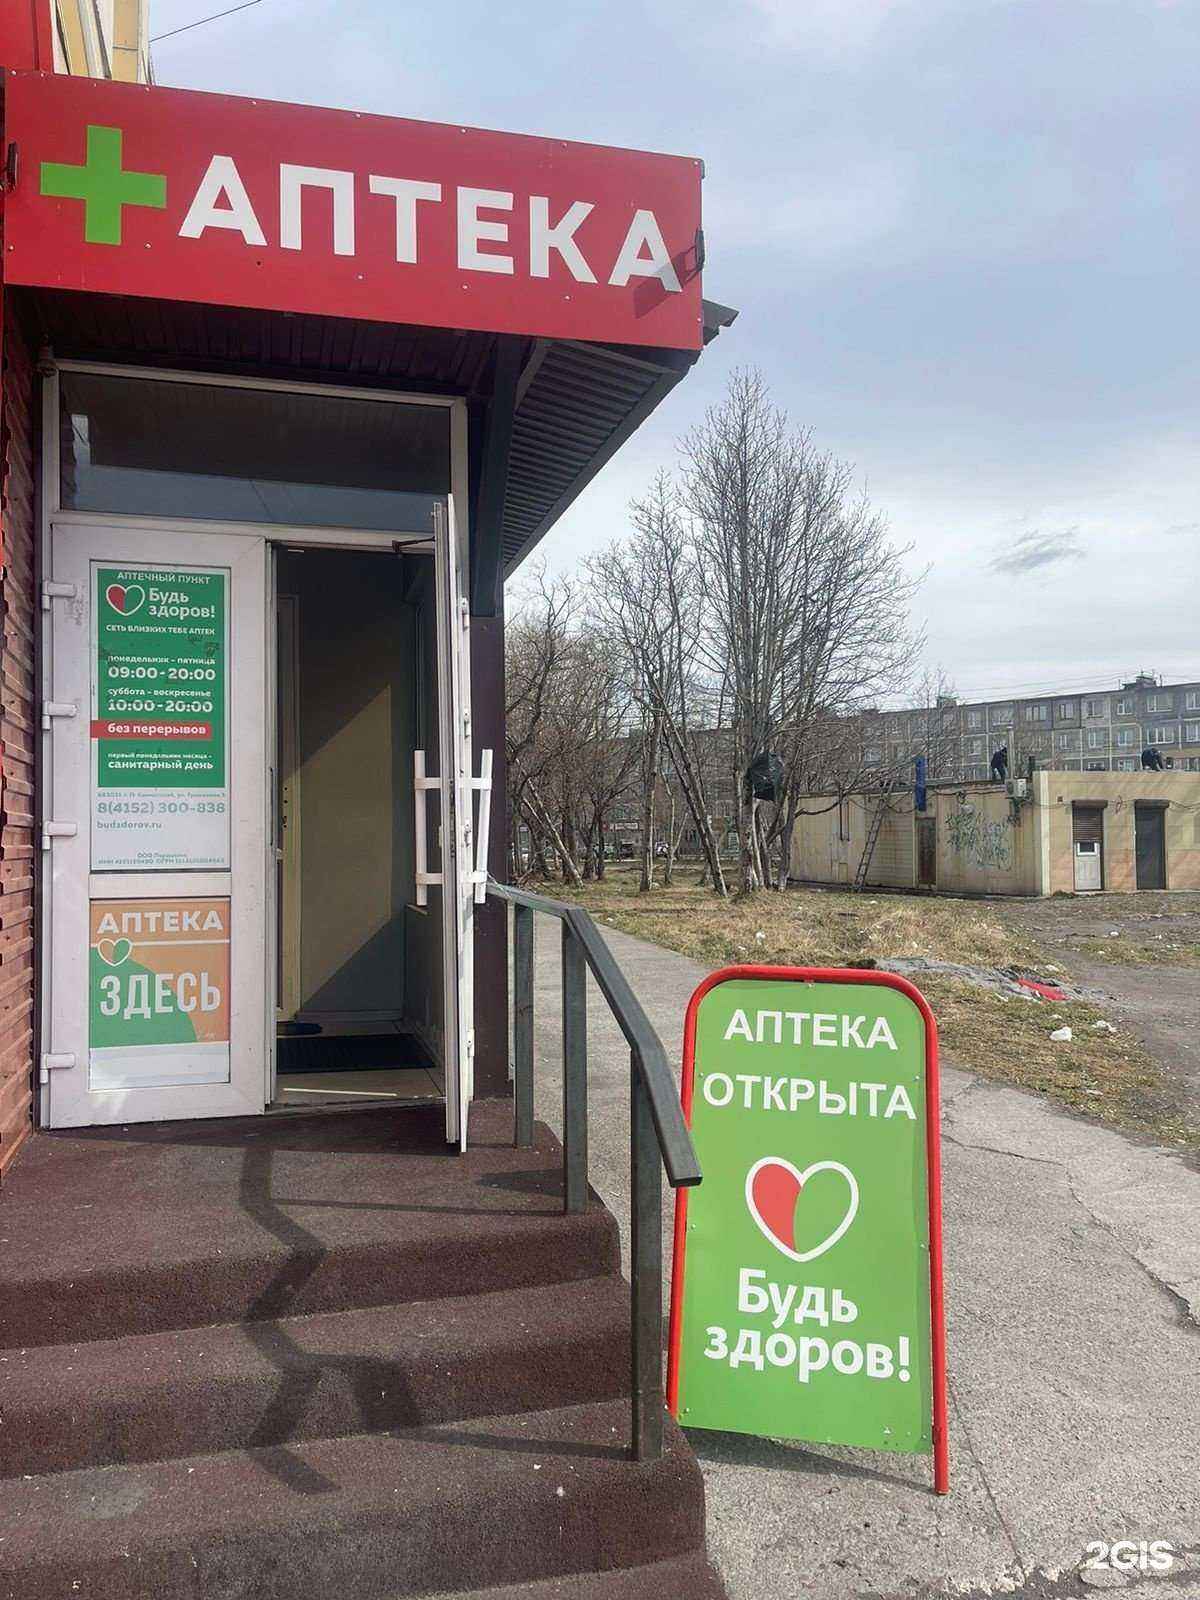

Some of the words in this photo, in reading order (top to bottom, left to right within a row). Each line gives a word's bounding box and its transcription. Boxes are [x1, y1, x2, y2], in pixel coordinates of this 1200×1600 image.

[178, 155, 682, 292] АПТЕКА
[117, 572, 176, 583] АПТЕЧНЫЙ
[178, 575, 211, 585] ПУНКТ
[148, 587, 189, 605] Будь
[148, 605, 215, 620] здоров!
[106, 624, 127, 632] СЕТЬ
[107, 655, 169, 664] понедельник
[177, 657, 216, 665] пятница
[108, 687, 145, 697] суббота
[153, 689, 211, 698] воскресенье
[107, 722, 130, 733] без
[132, 725, 206, 736] перерывов
[108, 760, 182, 771] санитарный
[184, 762, 213, 771] день
[97, 910, 223, 934] АПТЕКА
[100, 972, 221, 1020] ЗДЕСЬ
[724, 1008, 898, 1050] АПТЕКА
[703, 1072, 917, 1120] ОТКРЫТА
[738, 1267, 858, 1329] Будь
[703, 1326, 911, 1383] здоров!
